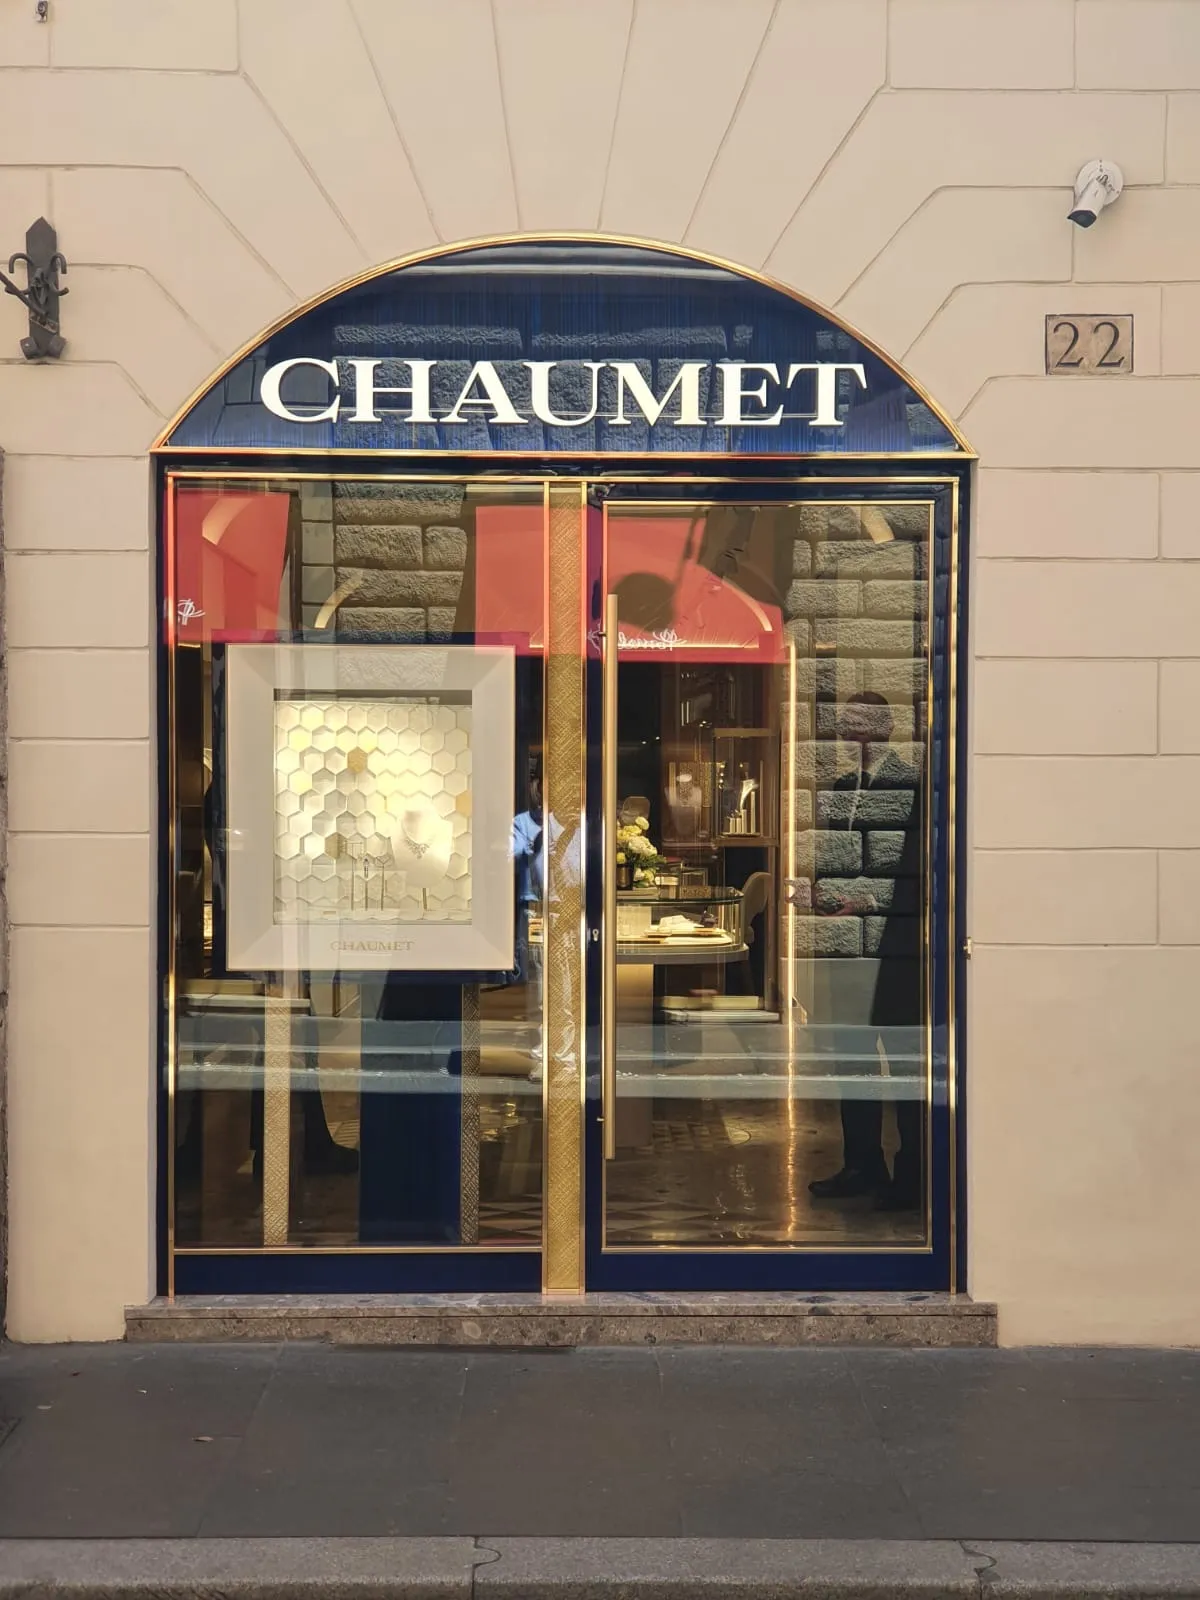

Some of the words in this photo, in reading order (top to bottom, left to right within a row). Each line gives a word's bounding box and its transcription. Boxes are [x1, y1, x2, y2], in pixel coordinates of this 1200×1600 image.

[1053, 321, 1125, 368] 22
[259, 357, 868, 427] CHAUMET
[330, 940, 416, 952] CHAUMET
